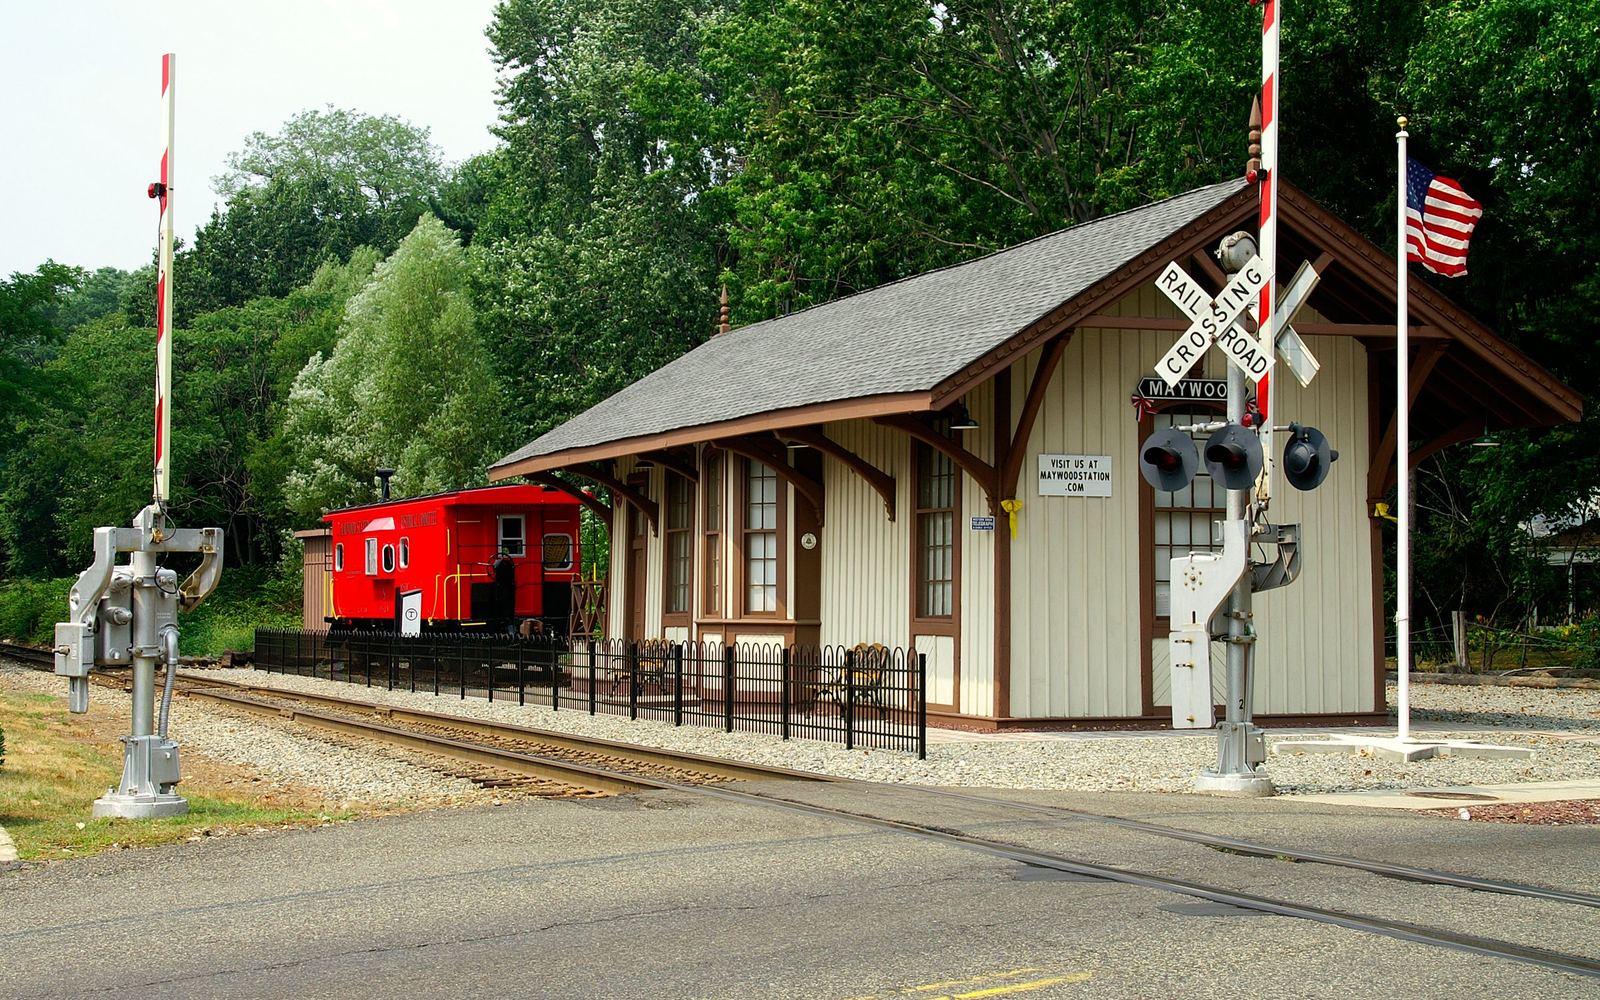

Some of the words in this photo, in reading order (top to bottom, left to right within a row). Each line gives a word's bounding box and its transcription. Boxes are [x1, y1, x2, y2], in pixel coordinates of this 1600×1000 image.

[1161, 269, 1201, 315] RAIL
[1166, 268, 1262, 375] CROSSING
[1221, 327, 1267, 374] ROAD
[1149, 381, 1228, 397] MAYWOO
[1051, 459, 1070, 468] VISIT
[1074, 459, 1084, 468] US
[1088, 460, 1098, 469] AT
[1040, 471, 1110, 481] MAYWOODSTATION
[1065, 483, 1084, 492] .COM
[1238, 699, 1244, 710] 2
